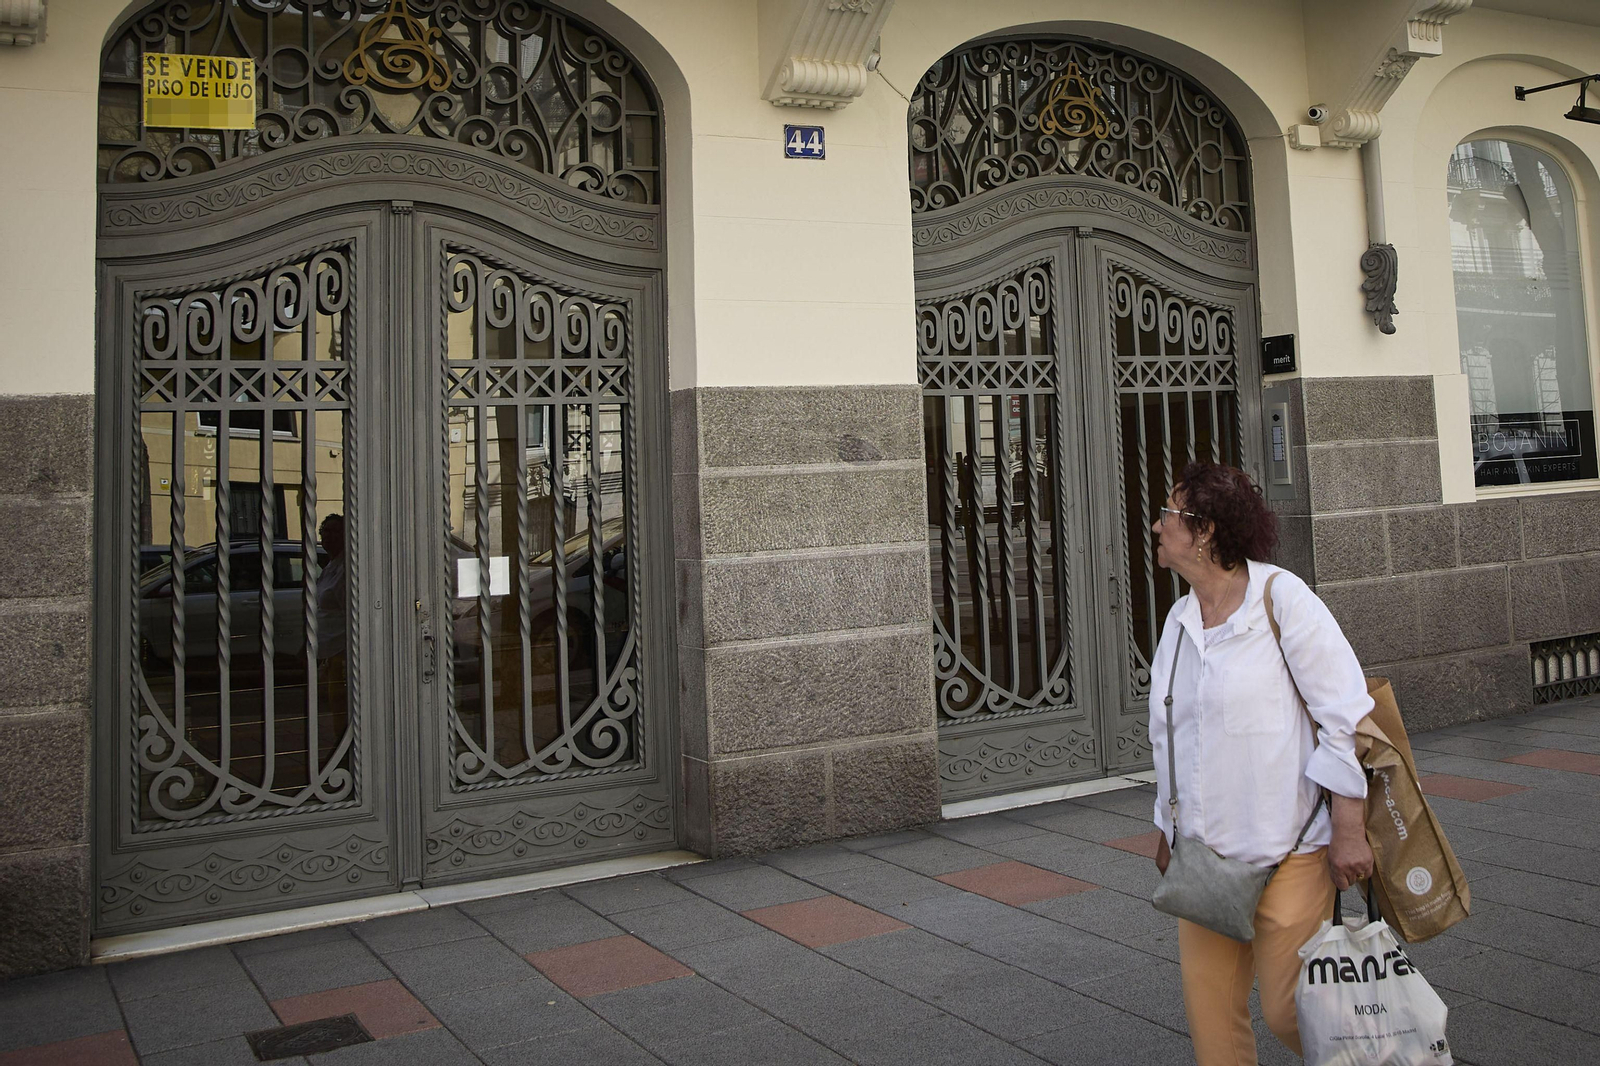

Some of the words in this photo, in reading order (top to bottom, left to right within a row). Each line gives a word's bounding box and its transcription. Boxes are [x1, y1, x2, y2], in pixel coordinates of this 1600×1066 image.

[146, 55, 169, 76] SE
[180, 57, 251, 80] VENDE
[147, 78, 183, 96] PISO
[190, 81, 209, 97] DE
[215, 82, 253, 99] LUJO
[787, 129, 823, 155] 44
[1273, 354, 1291, 365] merit
[1477, 428, 1574, 453] BOJANINI
[1480, 467, 1500, 477] HAIR
[1502, 466, 1519, 475] AND
[1522, 465, 1541, 474] SKIN
[1542, 461, 1577, 473] EXPERTS
[1354, 1003, 1388, 1016] MODA
